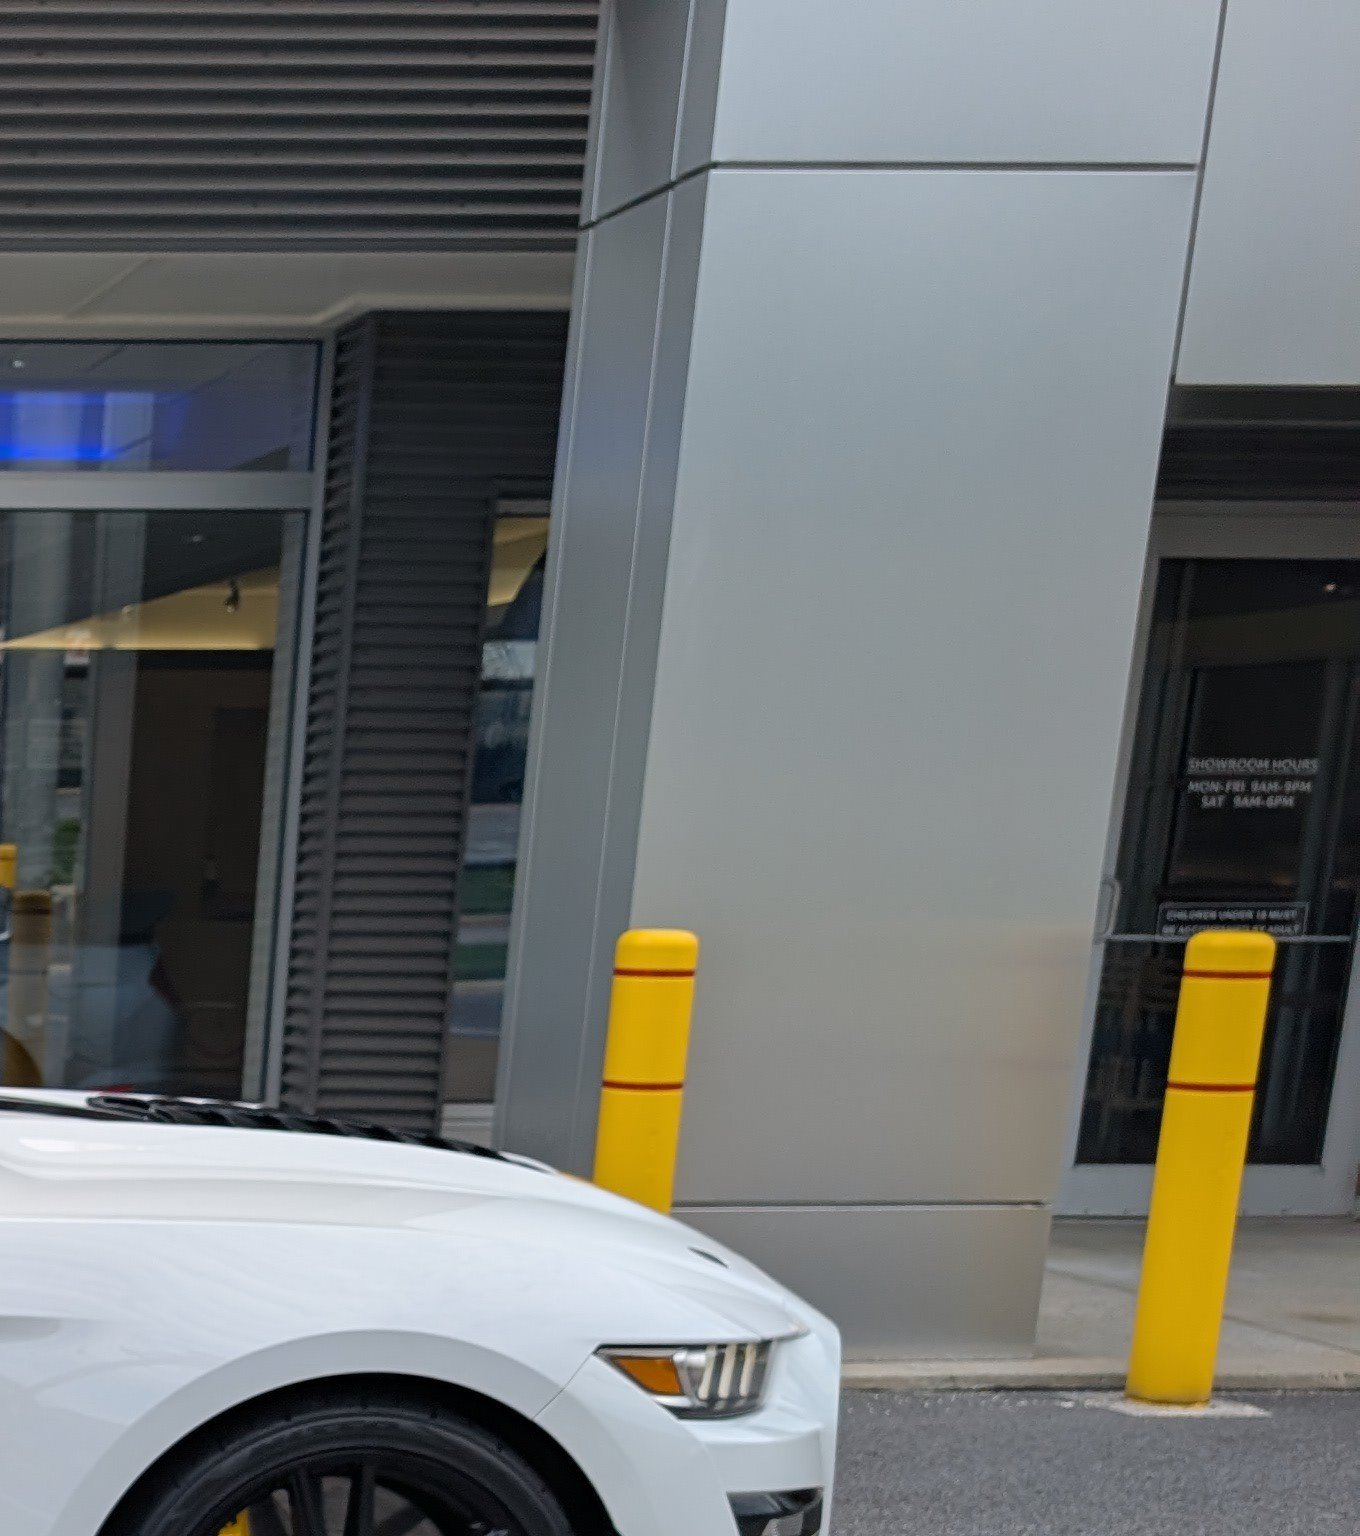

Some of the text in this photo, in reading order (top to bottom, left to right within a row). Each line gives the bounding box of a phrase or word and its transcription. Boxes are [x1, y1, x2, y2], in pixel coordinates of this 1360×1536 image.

[1187, 757, 1319, 774] SHOWROOM HOURS
[1200, 795, 1227, 809] SAT
